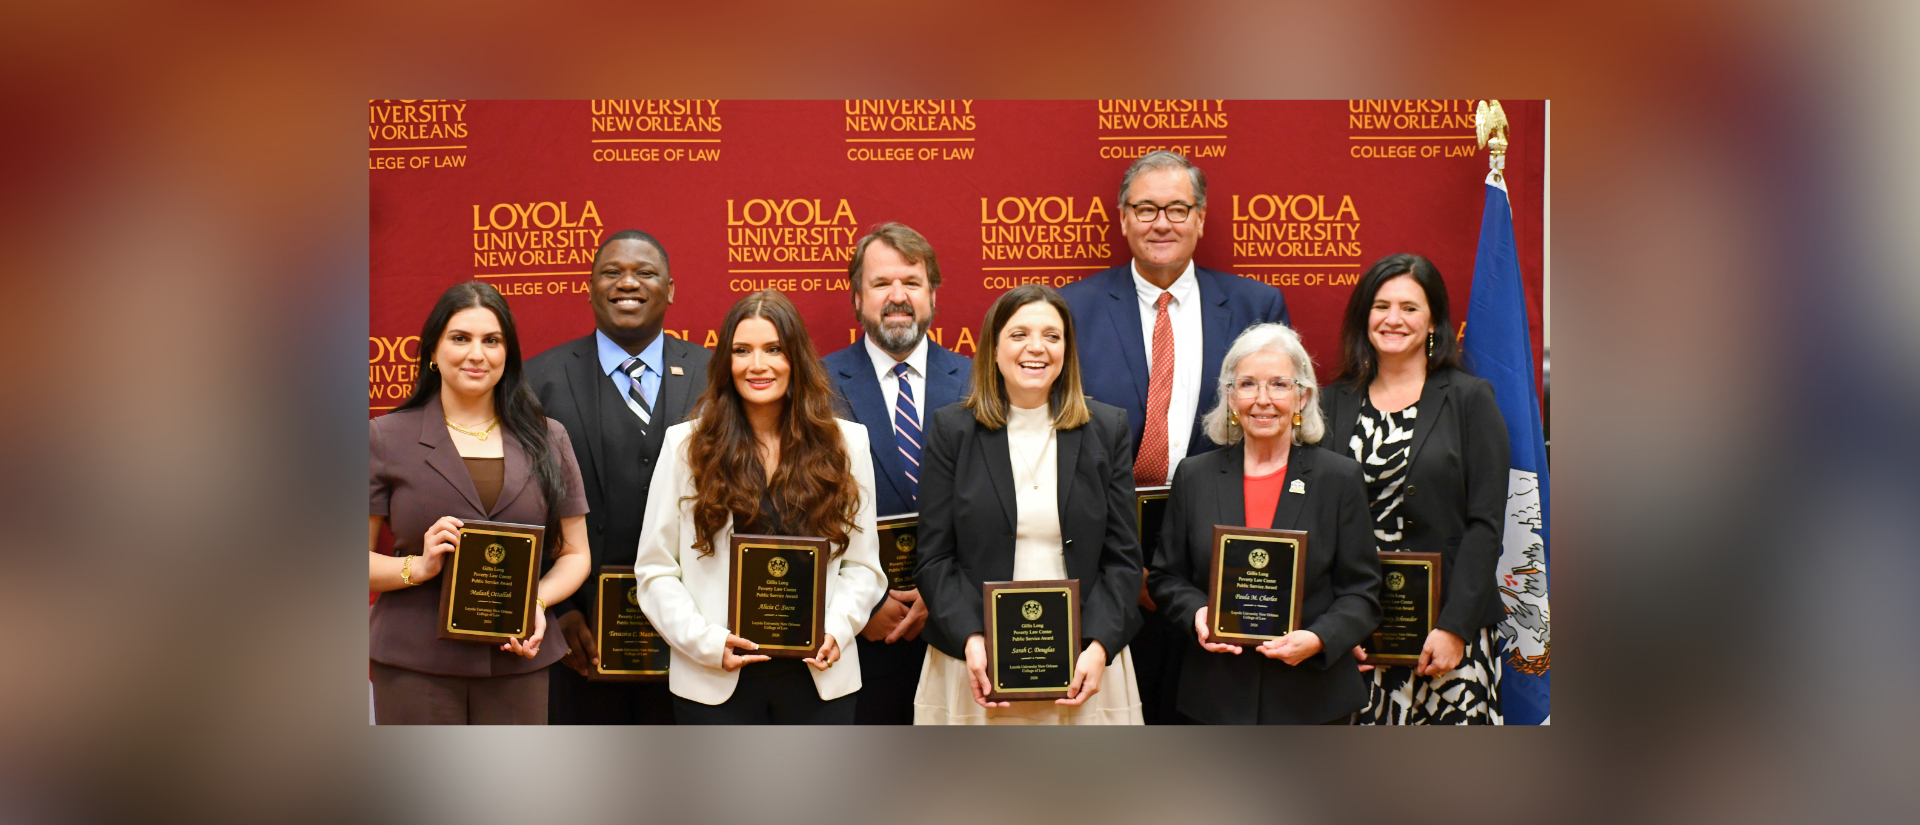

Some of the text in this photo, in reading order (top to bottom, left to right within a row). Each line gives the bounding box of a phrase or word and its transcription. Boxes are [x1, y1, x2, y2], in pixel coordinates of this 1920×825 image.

[369, 104, 467, 124] IVERSITY
[591, 99, 721, 116] UNIVERSITY
[845, 99, 974, 116] UNIVERSITY
[1098, 99, 1225, 114] UNIVERSITY
[1349, 99, 1476, 114] UNIVERSITY
[591, 116, 723, 132] NEW ORLEANS
[845, 116, 977, 132] NEW ORLEANS
[1098, 113, 1229, 130] NEW ORLEANS
[1349, 114, 1477, 129] NEW ORLEANS
[381, 123, 468, 140] ORLEANS
[593, 149, 721, 162] COLLEGE OF LAW
[847, 148, 975, 161] COLLEGE OF LAW
[1170, 146, 1191, 158] OF
[1195, 146, 1227, 158] LAW
[1350, 146, 1476, 158] COLLEGE OF LAW
[369, 155, 467, 169] LEGE OF LAW
[472, 200, 604, 231] LOYOLA
[726, 198, 858, 227] LOYOLA
[980, 196, 1109, 224] LOYOLA
[1232, 194, 1360, 222] LOYOLA
[727, 227, 858, 246] UNIVERSITY
[981, 224, 1110, 244] UNIVERSITY
[1233, 222, 1361, 241] UNIVERSITY
[473, 229, 604, 251] UNIVERSITY
[728, 247, 772, 263] NEW
[982, 244, 1111, 260] NEW ORLEANS
[1233, 242, 1362, 257] NEW ORLEANS
[474, 249, 599, 268] NEW ORLEAN
[729, 279, 798, 292] COLLEGE
[800, 278, 822, 291] OF
[983, 276, 1075, 290] COLLEGE OF
[1303, 273, 1360, 286] OF LAW
[546, 282, 568, 295] OF
[571, 281, 591, 294] LA
[1034, 646, 1055, 654] Douglas
